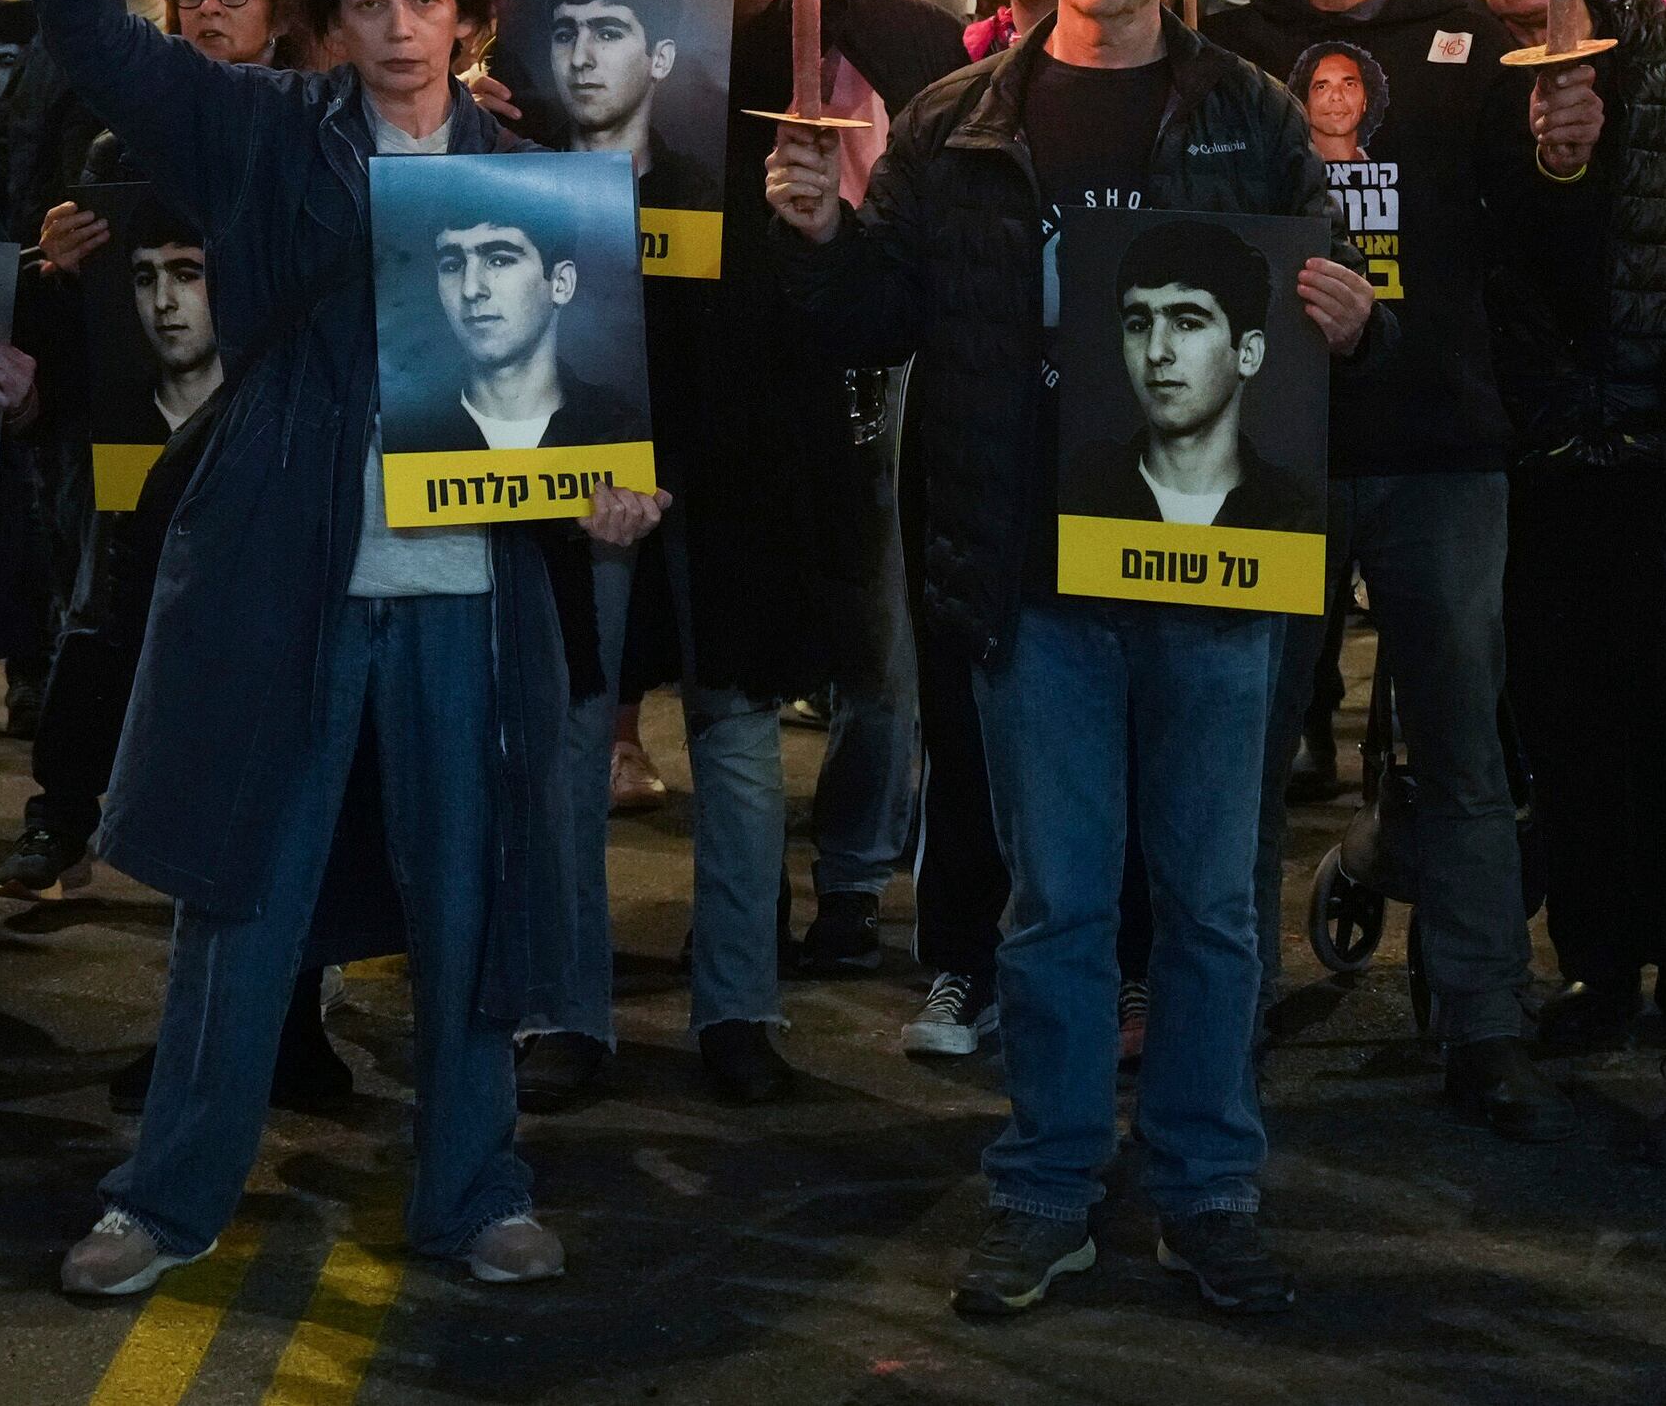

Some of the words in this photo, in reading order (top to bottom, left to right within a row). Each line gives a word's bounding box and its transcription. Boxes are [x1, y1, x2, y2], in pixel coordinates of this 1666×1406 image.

[1437, 38, 1466, 57] 465
[1199, 140, 1246, 155] Columbia
[1356, 235, 1399, 256] ואני
[426, 472, 529, 513] קלדרון
[1121, 547, 1208, 584] שוהם
[1218, 550, 1259, 589] טל
